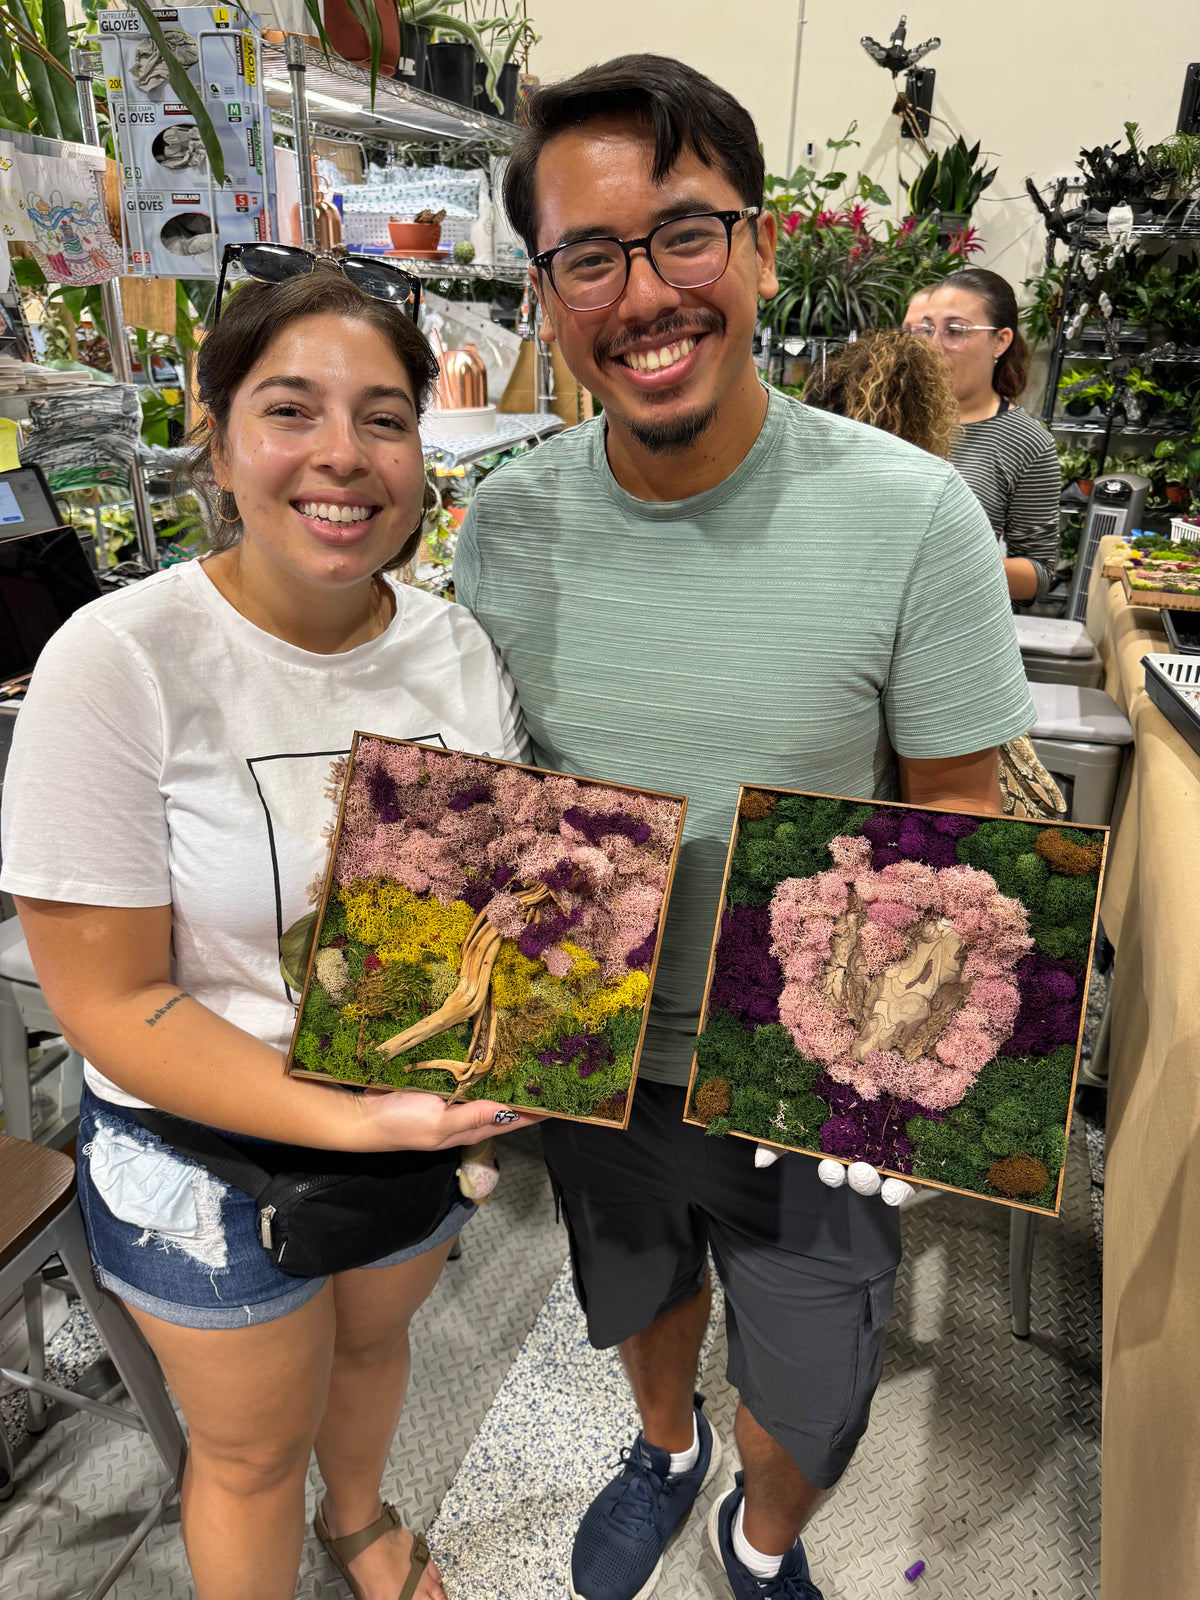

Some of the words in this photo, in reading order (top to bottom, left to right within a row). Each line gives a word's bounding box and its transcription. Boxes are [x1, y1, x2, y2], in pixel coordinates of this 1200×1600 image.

[219, 10, 225, 21] L
[101, 20, 139, 31] GLOVES
[235, 35, 243, 75] KIRKLAND
[230, 104, 239, 115] M
[238, 195, 246, 206] S
